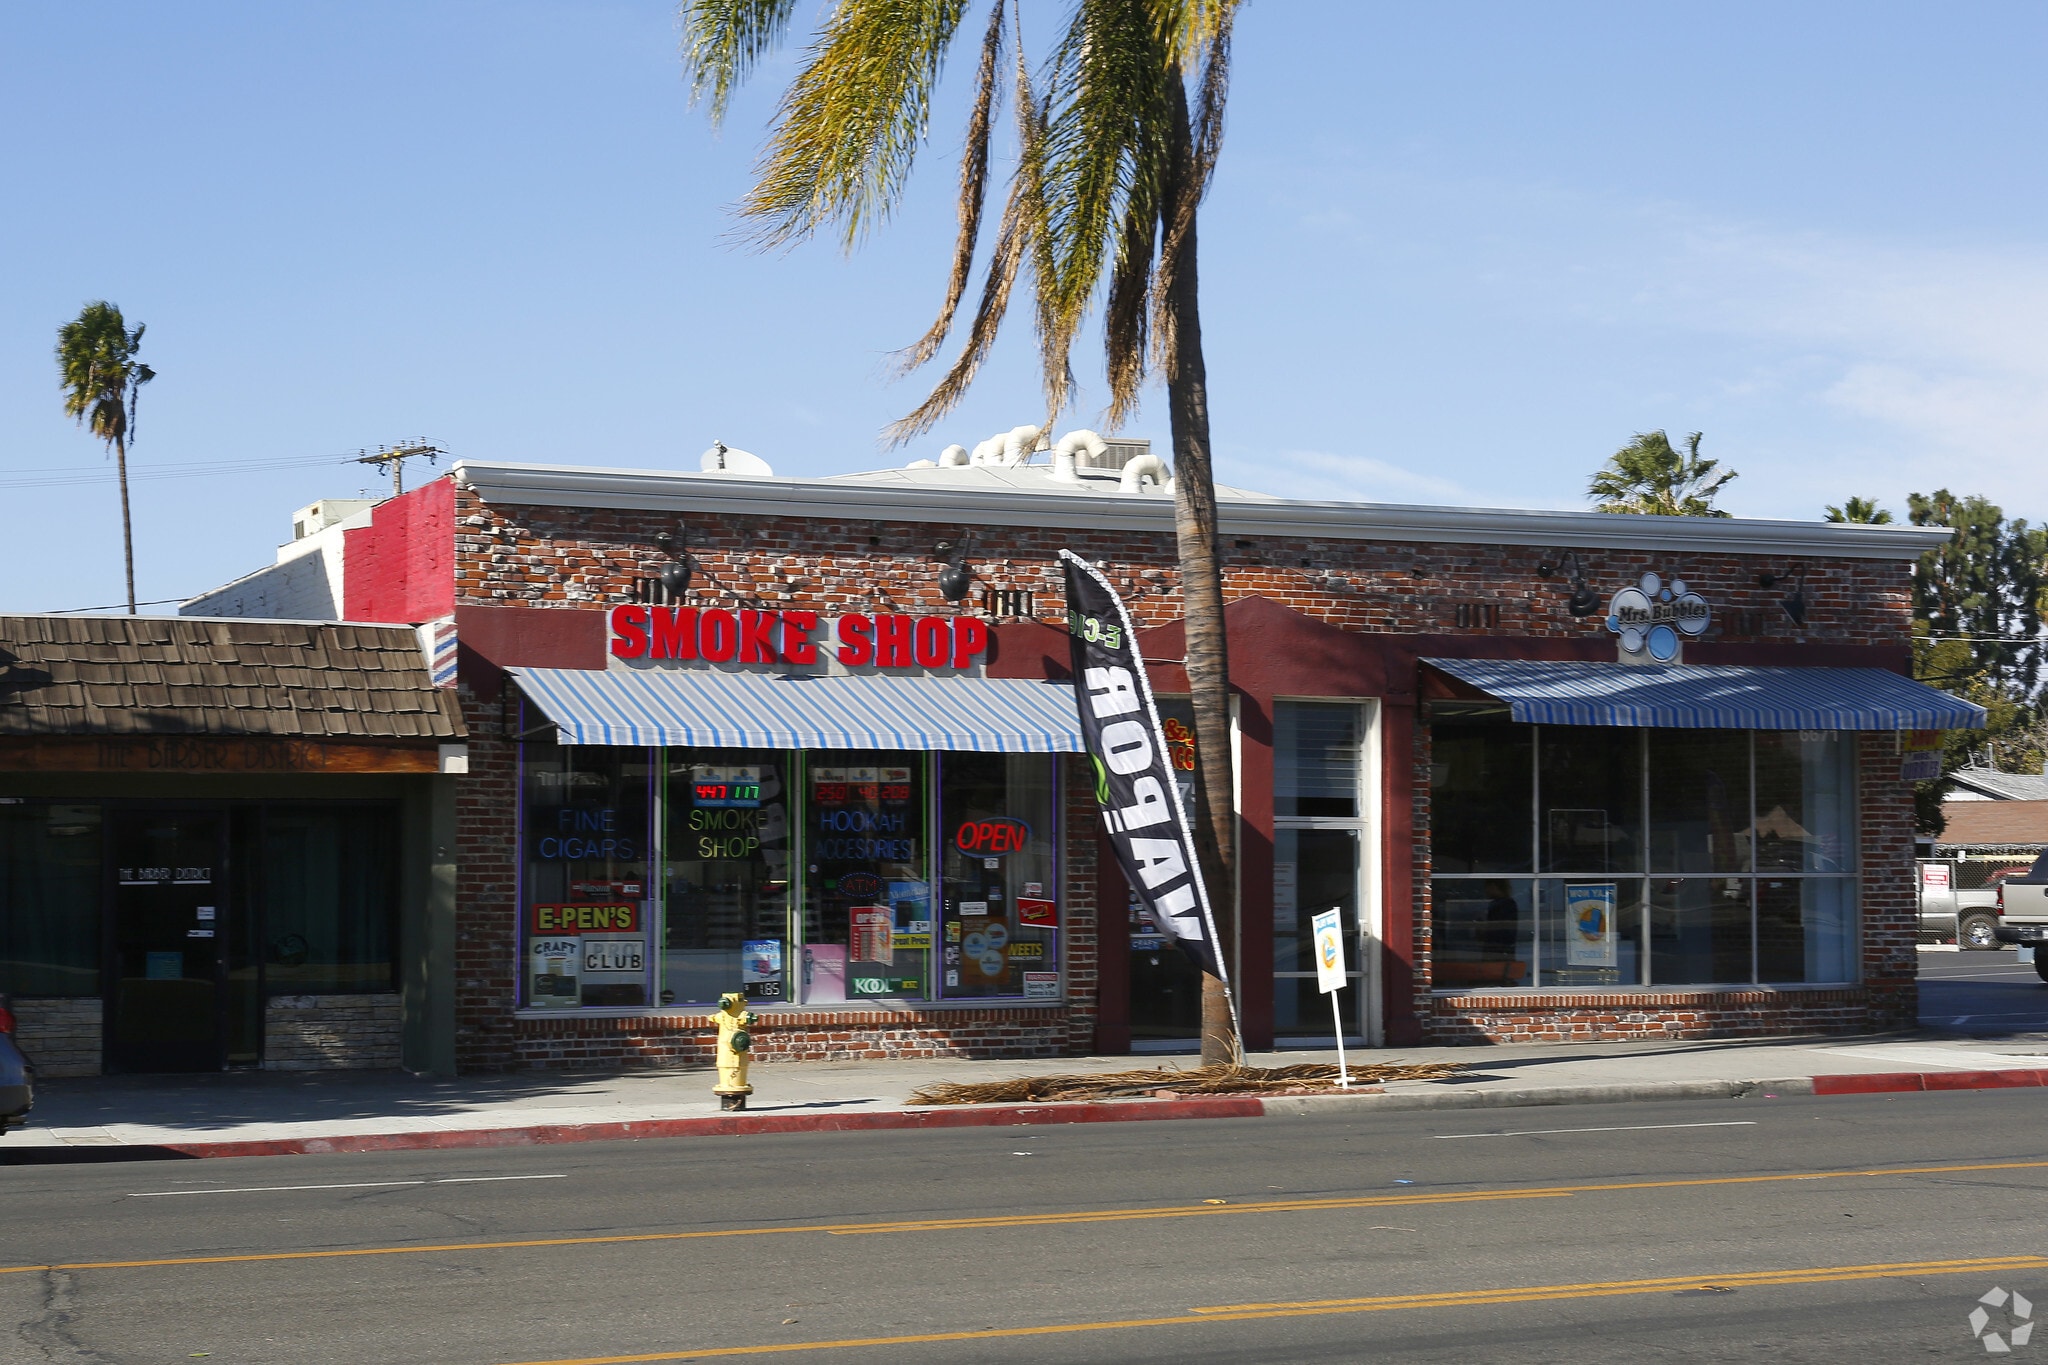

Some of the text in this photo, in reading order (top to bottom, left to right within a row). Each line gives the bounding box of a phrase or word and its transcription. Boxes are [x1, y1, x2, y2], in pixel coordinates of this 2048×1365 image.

[1619, 600, 1708, 622] Mrs. Bubbles
[610, 605, 988, 668] SMOKE SHOP
[98, 741, 328, 770] THE BARBER DISTRICT
[696, 784, 727, 799] 447
[734, 785, 760, 799] 117
[816, 785, 847, 801] 250
[858, 785, 879, 800] 40
[881, 785, 911, 800] 208
[557, 808, 616, 833] FINE
[688, 809, 769, 832] SMOKE
[819, 809, 906, 833] HOOKAH
[539, 836, 635, 860] CIGARS
[698, 836, 760, 859] SHOP
[955, 821, 1027, 853] OPEN
[814, 838, 912, 861] ACCESORIES
[138, 867, 173, 881] BARBER
[176, 867, 212, 881] DISTRICT
[846, 879, 878, 892] ATM
[537, 906, 634, 931] E-PEN'S
[534, 941, 578, 955] CRAFT
[587, 955, 642, 970] CLUB
[854, 978, 894, 994] KOOL
